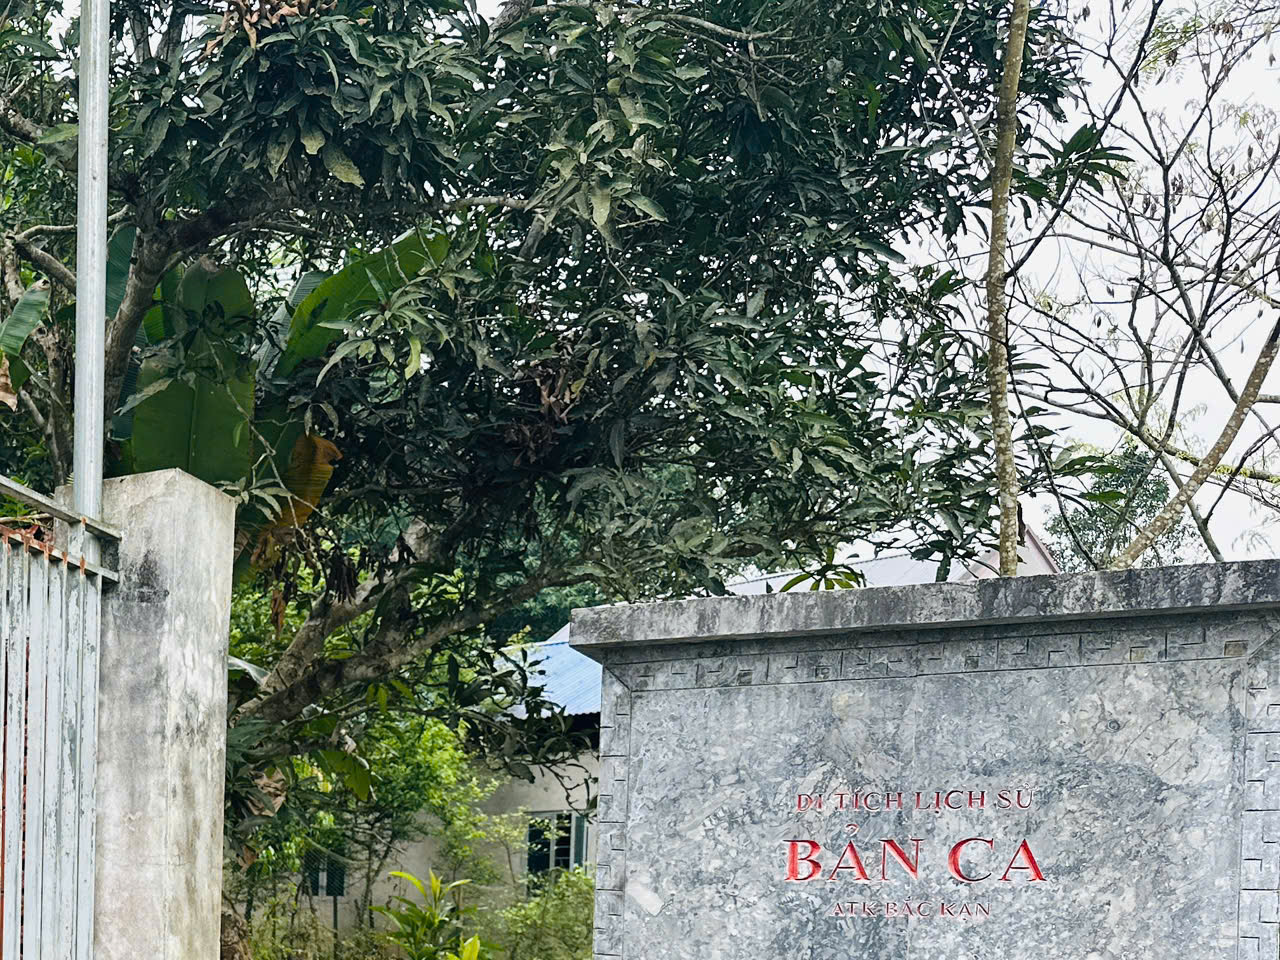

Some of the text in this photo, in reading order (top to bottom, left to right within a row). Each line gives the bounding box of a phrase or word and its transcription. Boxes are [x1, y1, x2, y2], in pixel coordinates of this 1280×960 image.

[797, 783, 1039, 814] DI TÍCH LỊCH SỬ
[783, 823, 1047, 883] BẢN CA
[833, 897, 991, 920] ATK BẮC KẠN
